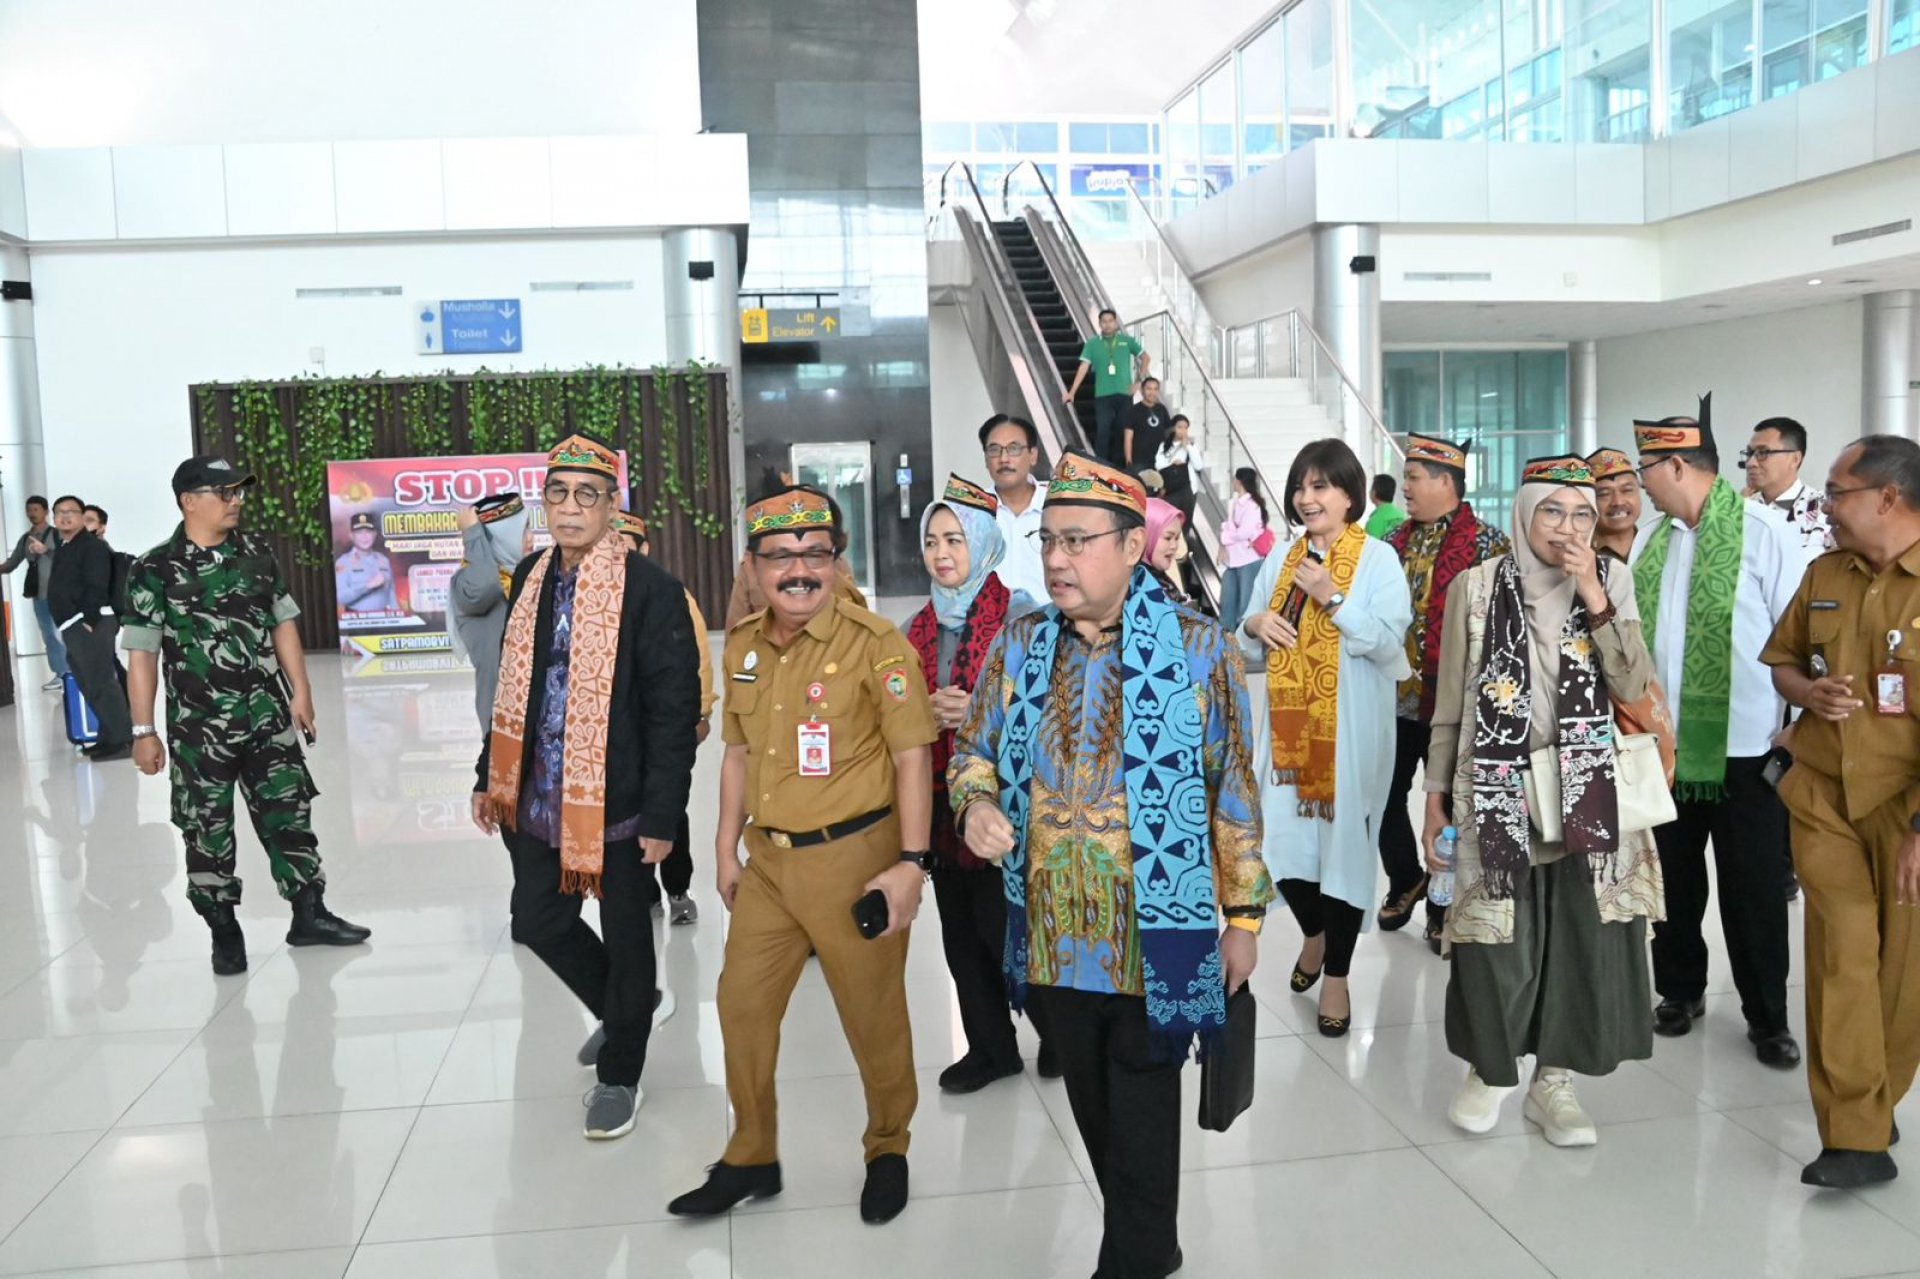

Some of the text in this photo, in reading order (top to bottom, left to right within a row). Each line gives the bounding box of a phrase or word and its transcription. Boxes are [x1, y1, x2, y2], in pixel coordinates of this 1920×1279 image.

[796, 312, 815, 323] Lift
[451, 328, 488, 338] Toilet
[772, 326, 815, 337] Elevator
[395, 469, 513, 505] STOP
[383, 511, 459, 535] MEMBAKAR
